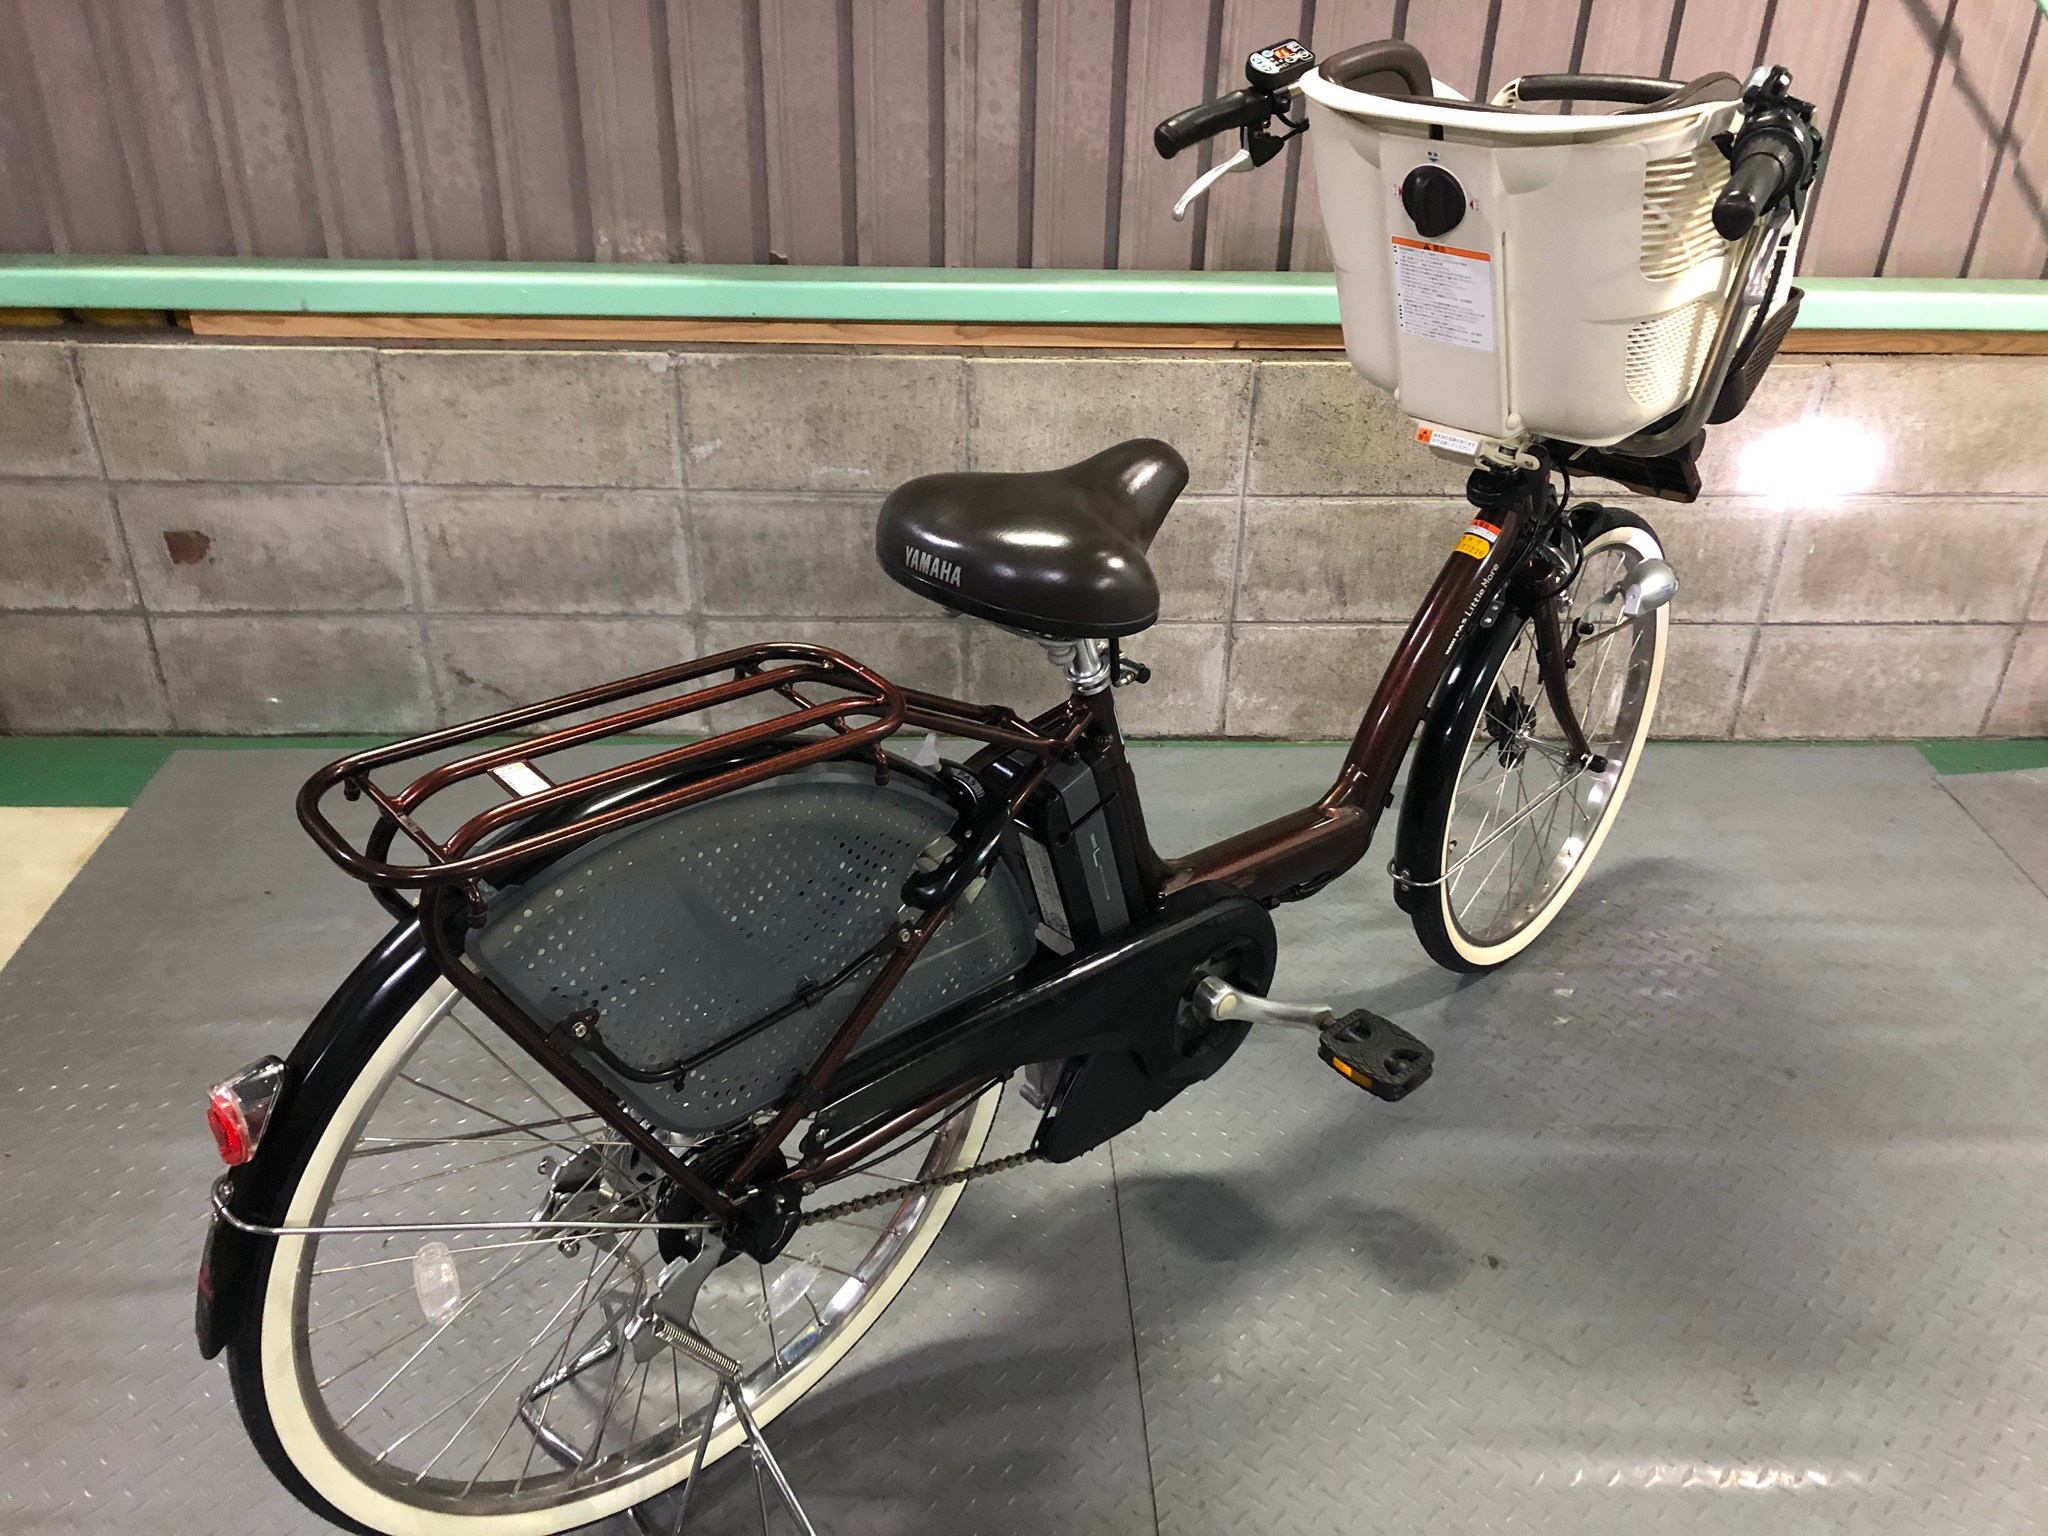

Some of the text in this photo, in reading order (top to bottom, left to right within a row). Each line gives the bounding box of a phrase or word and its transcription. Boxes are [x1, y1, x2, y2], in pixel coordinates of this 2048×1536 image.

[905, 545, 962, 588] YAMAHA
[1464, 588, 1485, 617] Little
[1480, 563, 1500, 588] More
